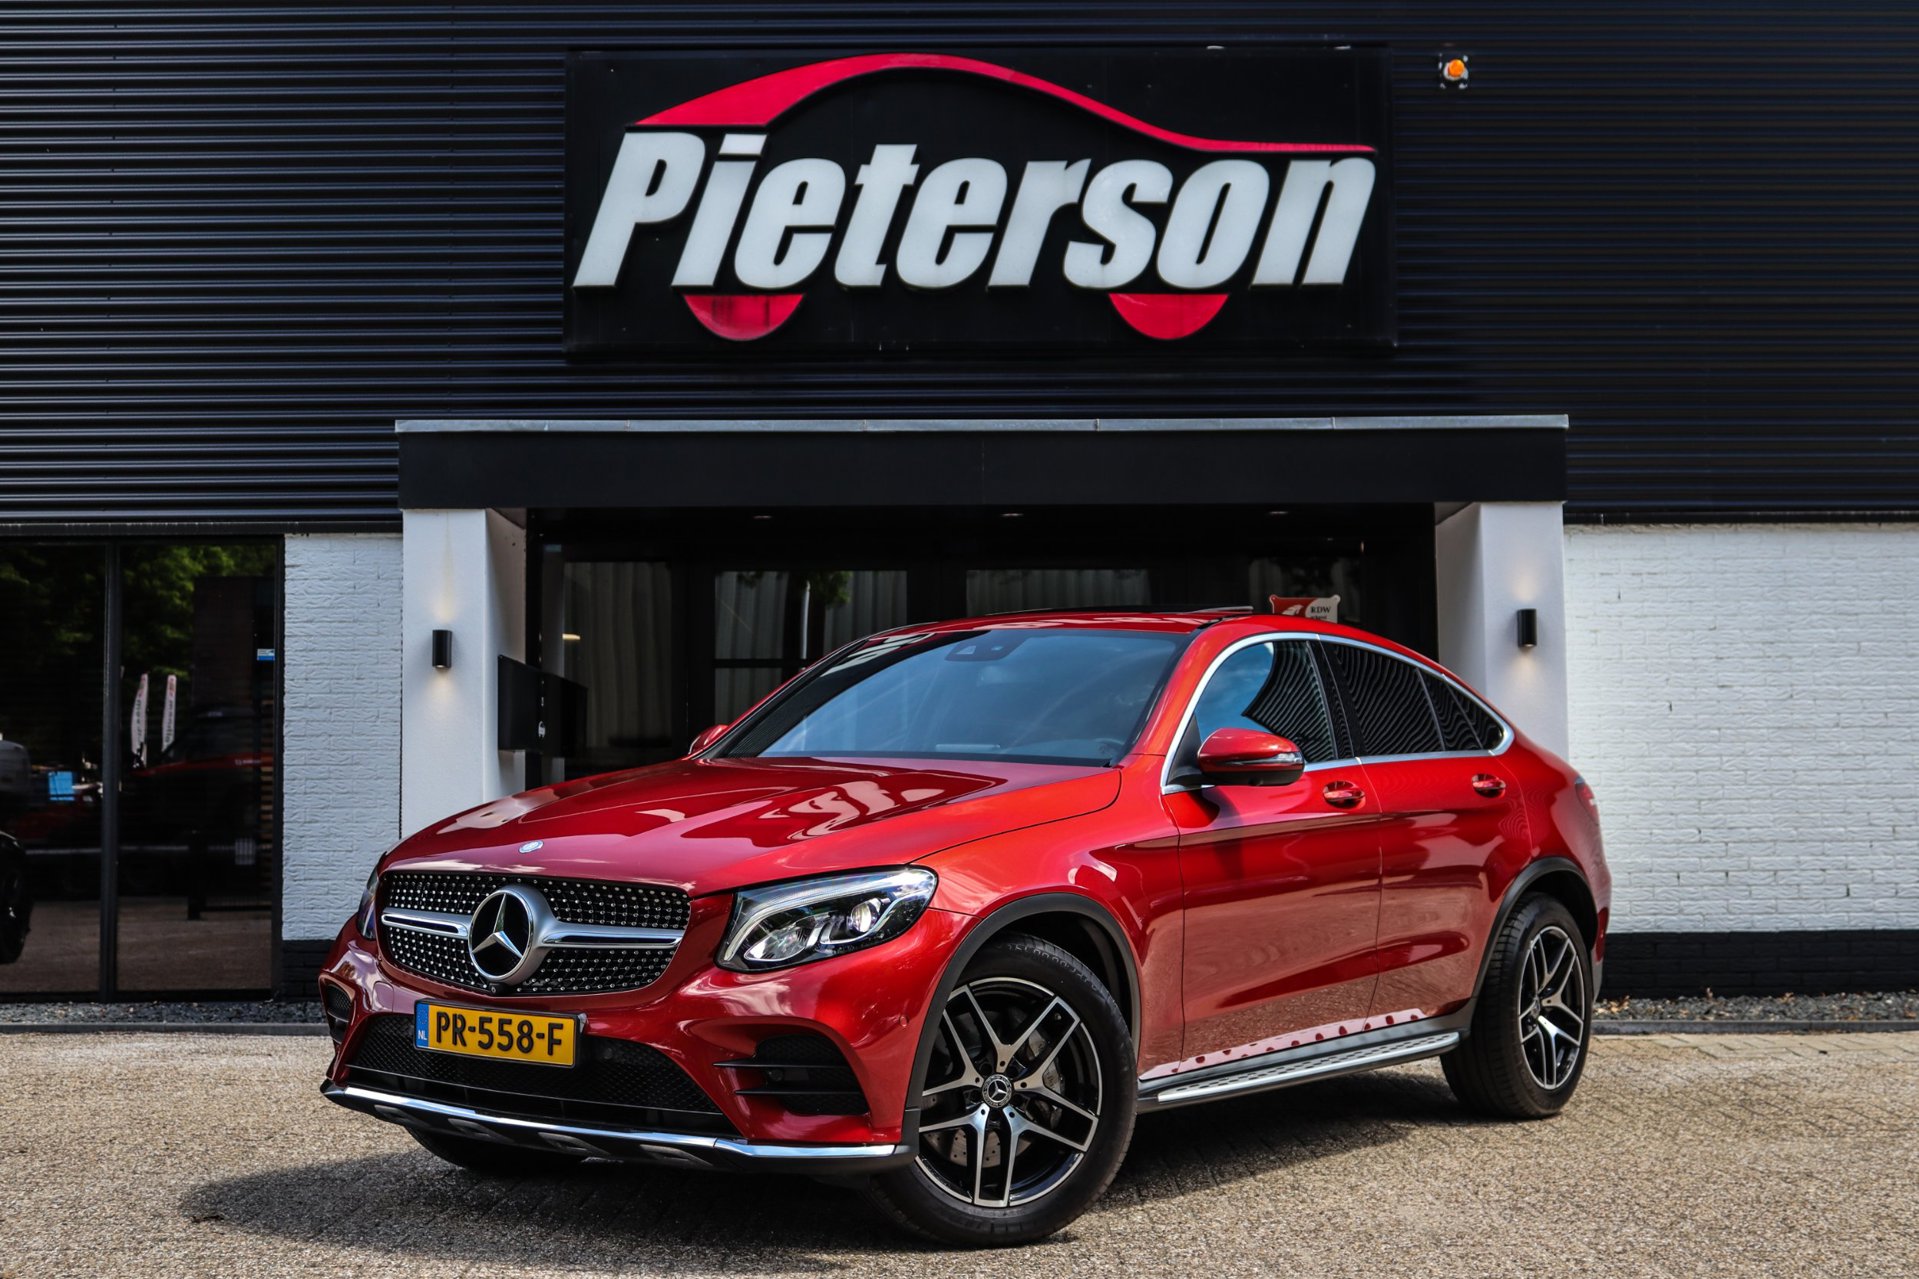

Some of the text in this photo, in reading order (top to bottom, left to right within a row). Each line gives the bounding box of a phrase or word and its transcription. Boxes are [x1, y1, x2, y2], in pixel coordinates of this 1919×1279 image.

[573, 132, 1377, 288] Pieterson
[417, 1012, 564, 1055] NL PR-558-F
